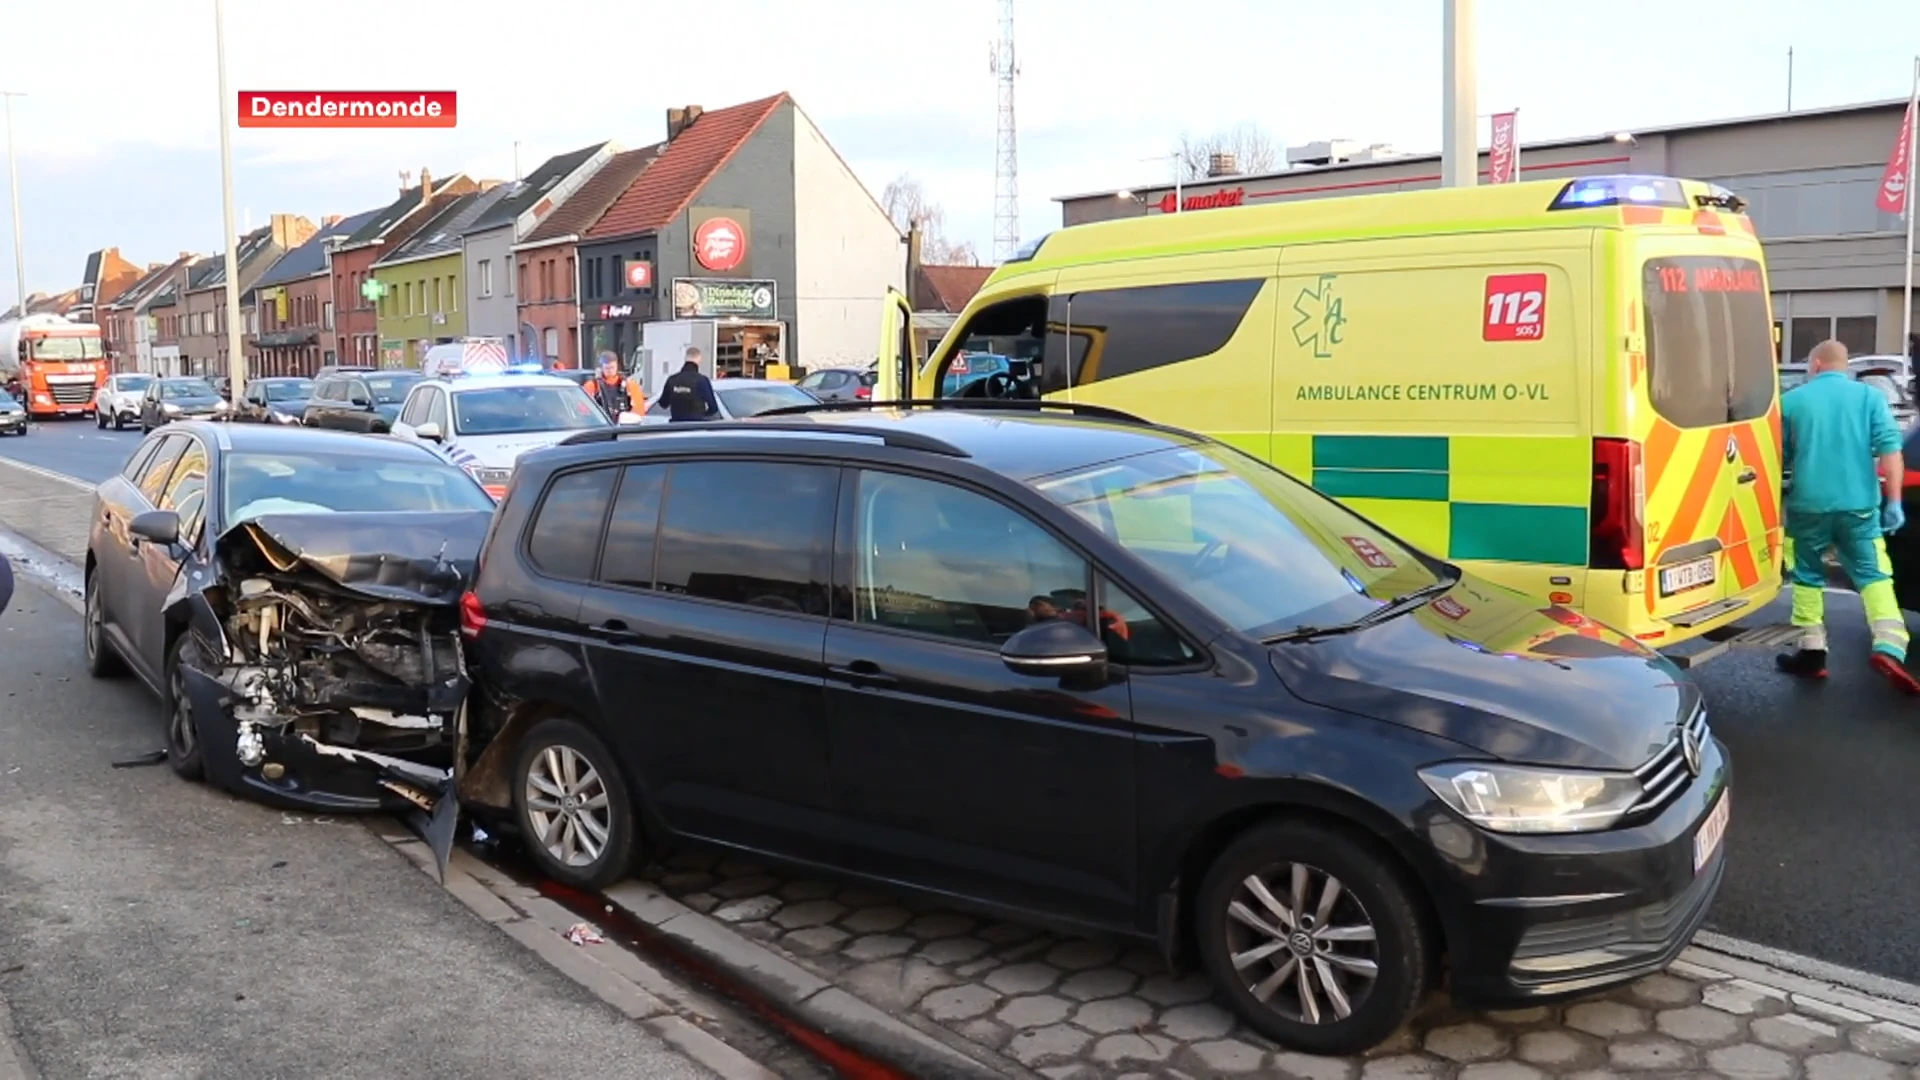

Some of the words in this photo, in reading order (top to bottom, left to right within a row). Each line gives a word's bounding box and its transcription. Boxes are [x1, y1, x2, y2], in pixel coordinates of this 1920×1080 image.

[1184, 186, 1246, 211] market
[1659, 267, 1688, 292] 112
[1488, 291, 1542, 325] 112
[1296, 384, 1401, 401] AMBULANCE
[1407, 384, 1496, 401] CENTRUM
[1502, 384, 1549, 401] O-VL
[1647, 521, 1660, 544] 02
